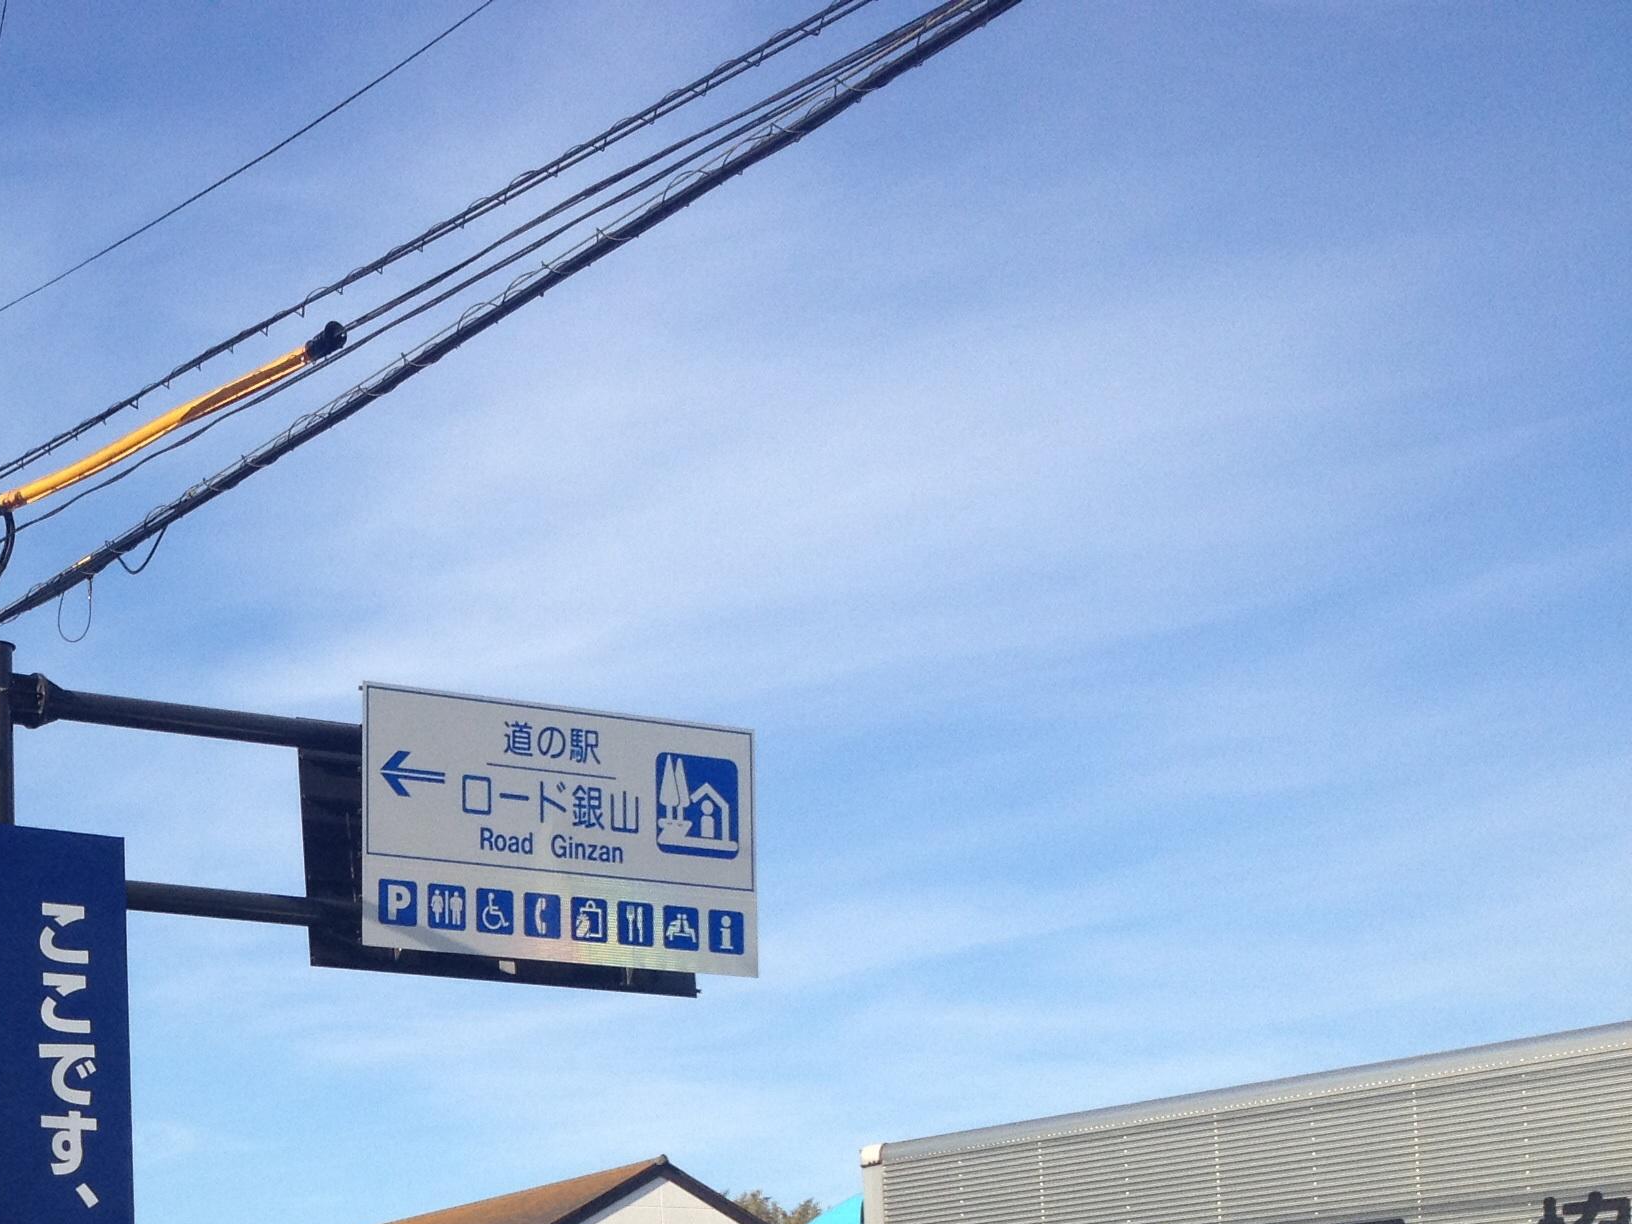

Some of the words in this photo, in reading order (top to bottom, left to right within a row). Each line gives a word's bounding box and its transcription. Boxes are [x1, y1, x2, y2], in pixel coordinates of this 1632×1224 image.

[503, 720, 601, 765] 道の駅
[462, 774, 640, 834] ロード銀山
[479, 827, 534, 855] Road
[551, 835, 624, 864] Ginzan
